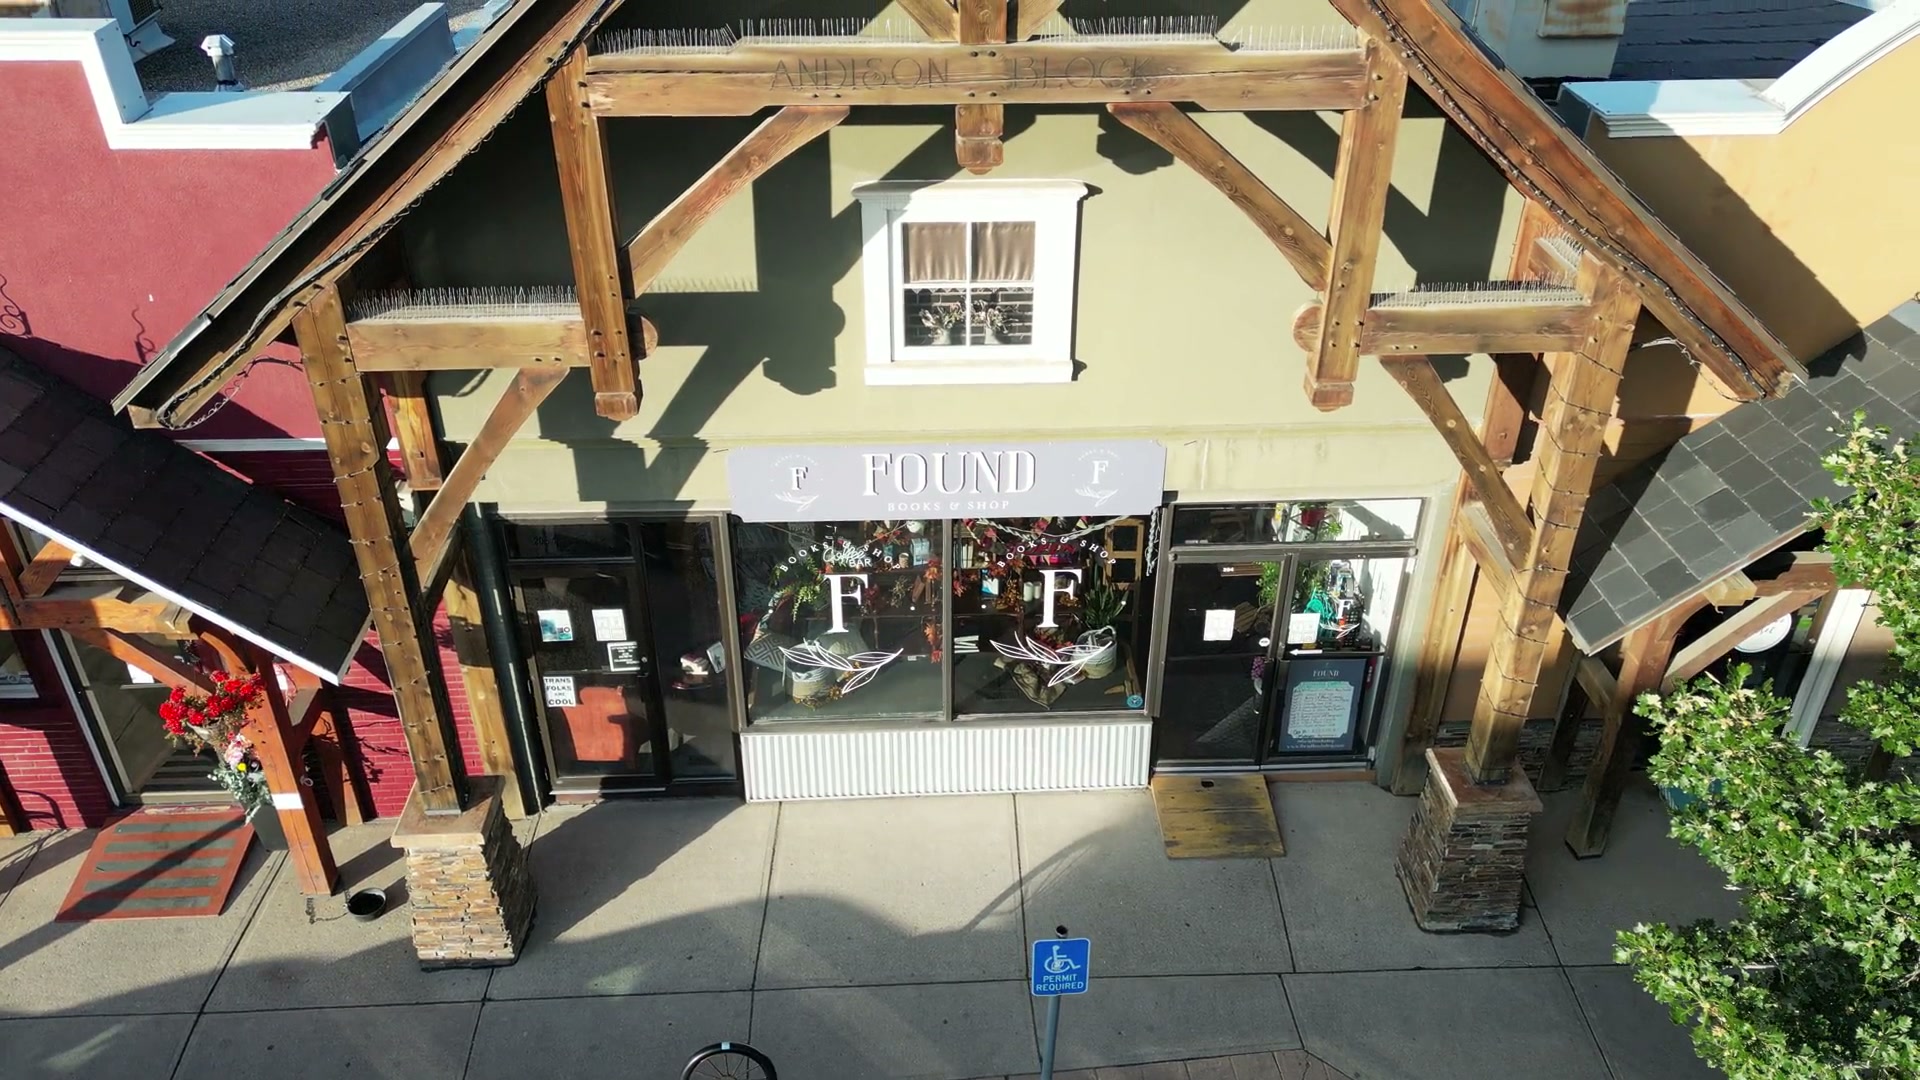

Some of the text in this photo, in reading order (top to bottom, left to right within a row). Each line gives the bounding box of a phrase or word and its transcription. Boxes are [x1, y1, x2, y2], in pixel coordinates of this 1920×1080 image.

[770, 55, 1153, 92] ANDISON BLOCK
[791, 466, 808, 491] F
[861, 449, 1036, 497] FOUND
[1091, 460, 1108, 484] F
[888, 499, 1010, 512] BOOKS & SHOP
[779, 541, 829, 573] BOOKS
[863, 543, 901, 570] SHOP
[848, 557, 872, 568] BAR
[996, 537, 1047, 568] BOOKS
[1080, 539, 1117, 565] SHOP
[824, 573, 869, 633] F
[1036, 568, 1082, 629] F
[1036, 982, 1084, 991] REQUIRED
[1043, 974, 1078, 983] PERMIT
